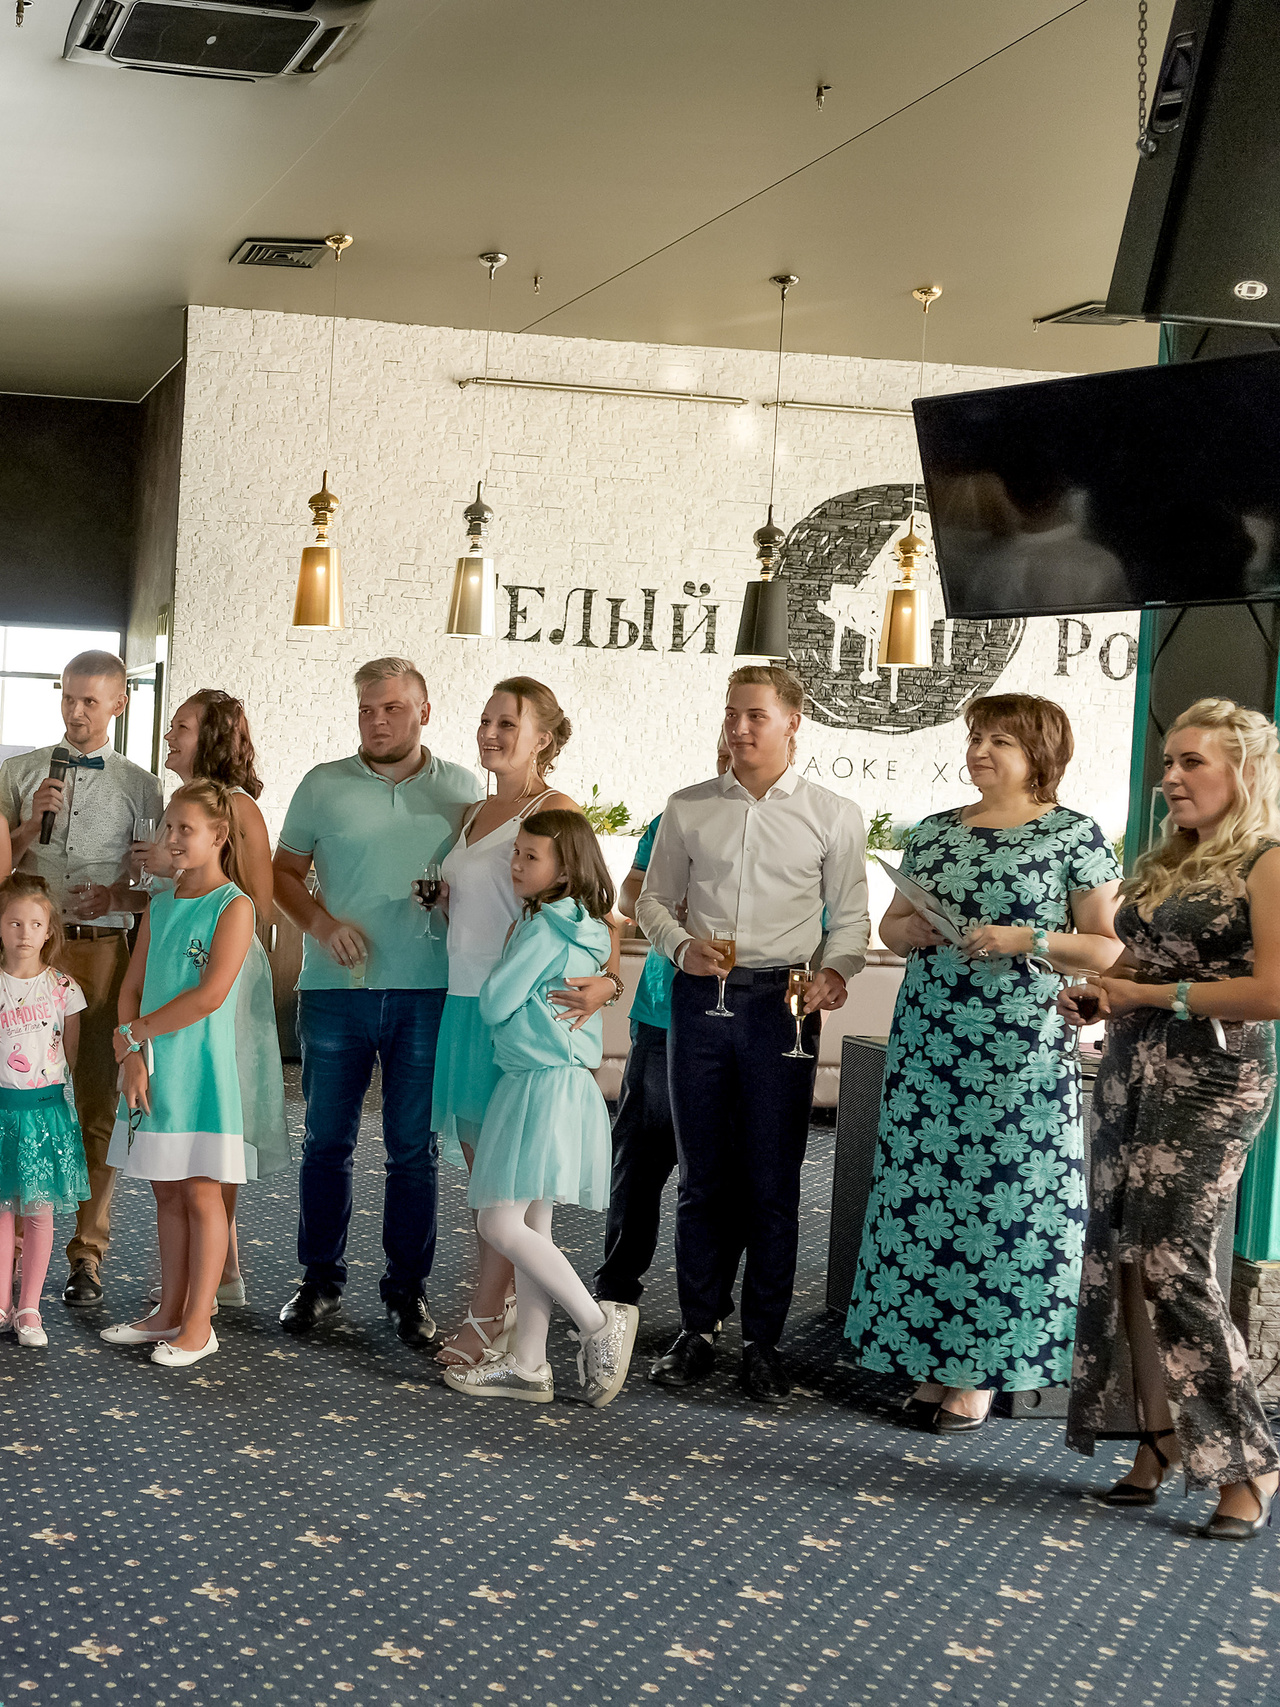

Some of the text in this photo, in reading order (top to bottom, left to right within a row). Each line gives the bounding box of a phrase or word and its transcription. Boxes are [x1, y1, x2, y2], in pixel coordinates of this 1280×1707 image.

[496, 574, 1139, 681] ЕЛЫЙ РО
[803, 756, 973, 785] АОКЕ ХО
